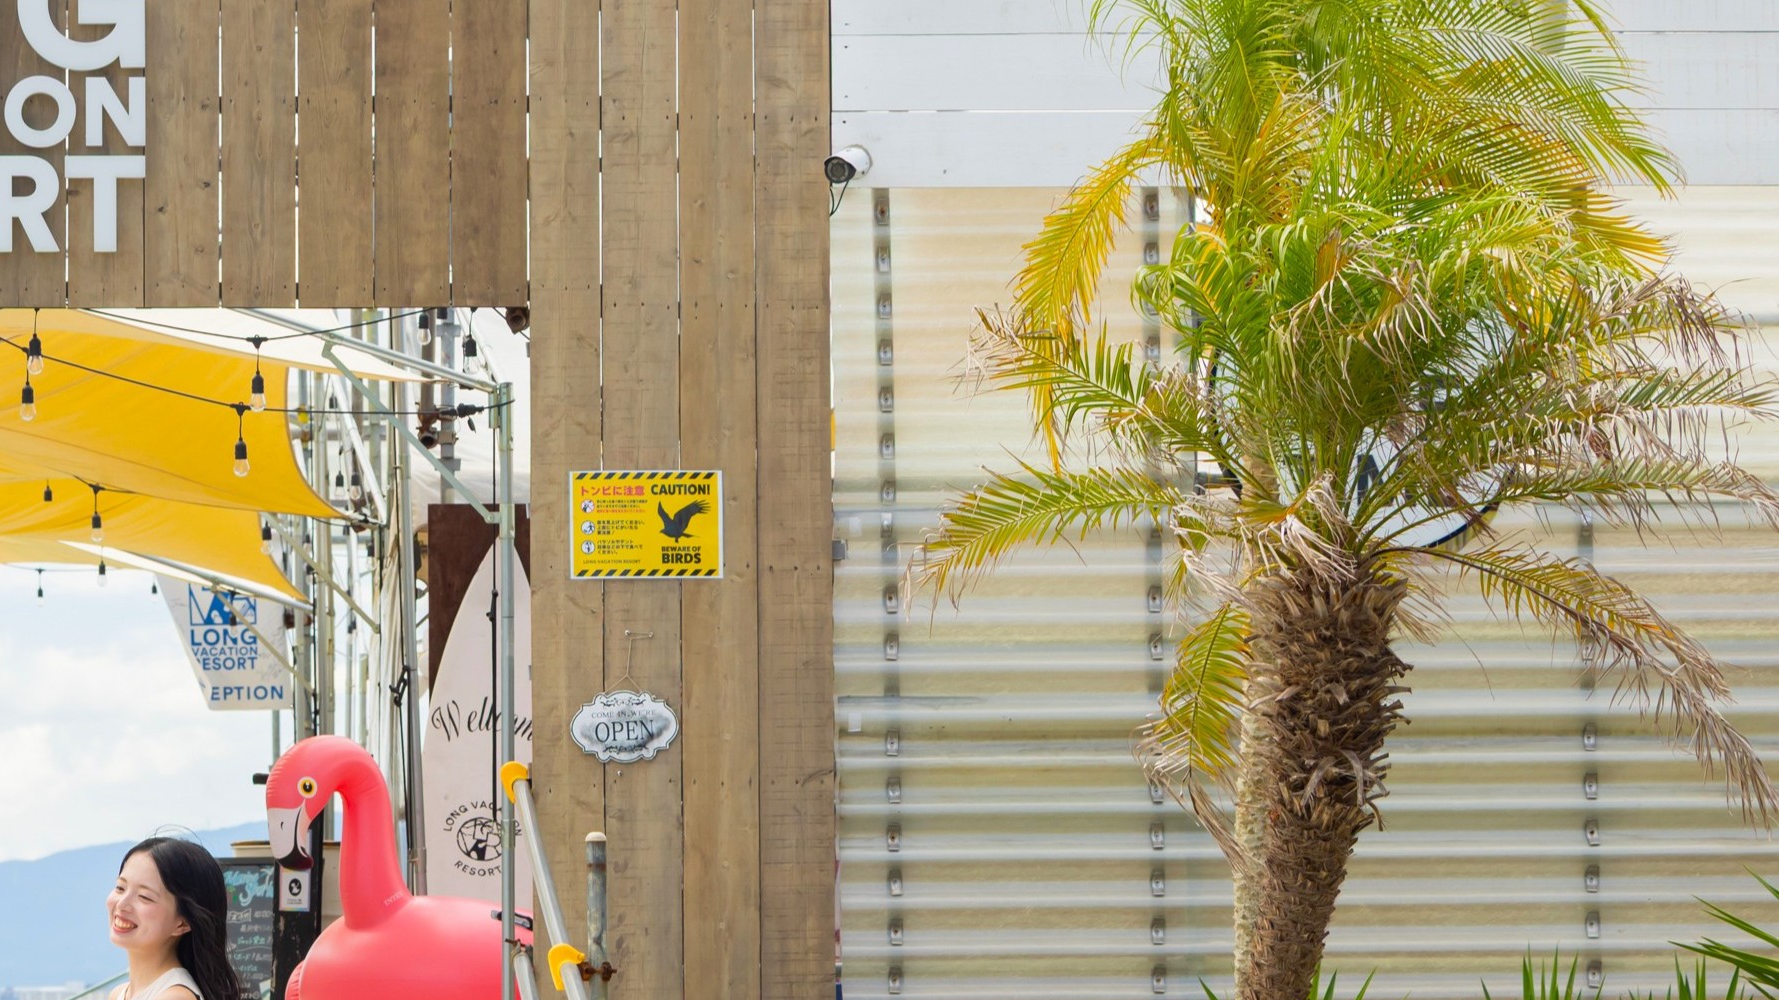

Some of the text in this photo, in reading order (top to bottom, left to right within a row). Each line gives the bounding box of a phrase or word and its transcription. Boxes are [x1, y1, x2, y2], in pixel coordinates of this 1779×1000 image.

[581, 485, 645, 497] トンビに注意
[651, 484, 711, 496] CAUTION!
[661, 553, 702, 564] BIRDS
[190, 628, 258, 646] LONG
[192, 646, 258, 657] VACATION
[196, 656, 258, 671] ESORT
[210, 685, 284, 701] EPTION
[591, 711, 613, 719] COME
[595, 720, 655, 743] OPEN
[443, 805, 469, 832] LONG
[454, 860, 502, 877] RESORT
